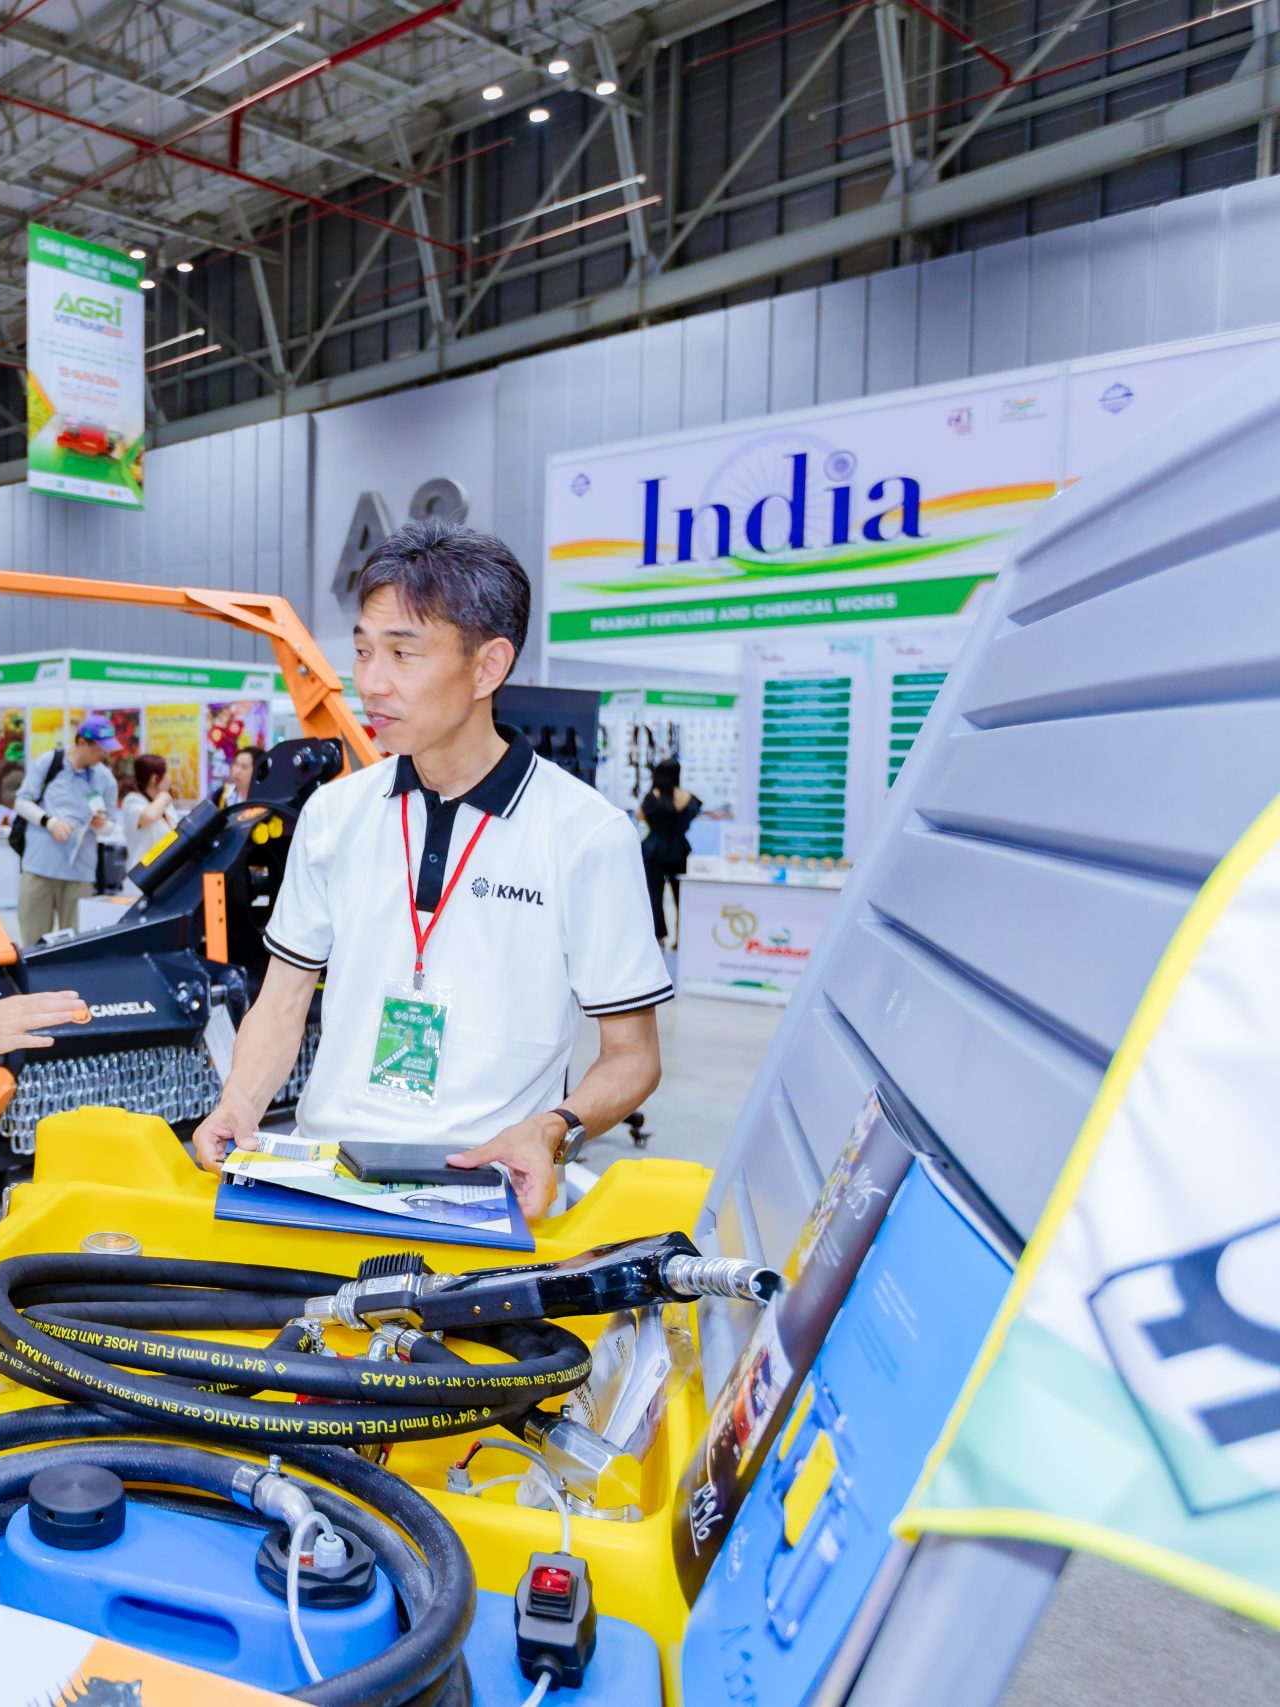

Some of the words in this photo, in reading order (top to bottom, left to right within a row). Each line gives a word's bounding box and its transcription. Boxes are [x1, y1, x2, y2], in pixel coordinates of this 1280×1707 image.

[636, 450, 932, 569] India
[590, 613, 647, 632] PRABHAT
[650, 608, 716, 628] FERTILIZER
[719, 605, 749, 622] AND
[752, 597, 833, 620] CHEMICAL
[836, 592, 898, 612] WORKS
[497, 884, 544, 906] KMVL
[89, 1000, 156, 1018] CANCELA
[49, 1324, 78, 1341] STATIC
[79, 1330, 103, 1346] ANTI
[15, 1339, 42, 1363] RAAS
[104, 1335, 138, 1352] HOSE
[141, 1341, 175, 1359] FUEL
[177, 1349, 208, 1361] mm)
[211, 1353, 233, 1366] (19
[237, 1358, 267, 1372] 3/4"
[361, 1371, 405, 1388] RAAS
[557, 1366, 579, 1384] STATIC
[203, 1407, 260, 1430] STATIC
[264, 1417, 303, 1433] ANTI
[400, 1417, 429, 1432] mm)
[431, 1412, 452, 1428] (19
[453, 1408, 478, 1425] 3/4"
[307, 1420, 353, 1435] HOSE
[356, 1420, 397, 1434] FUEL
